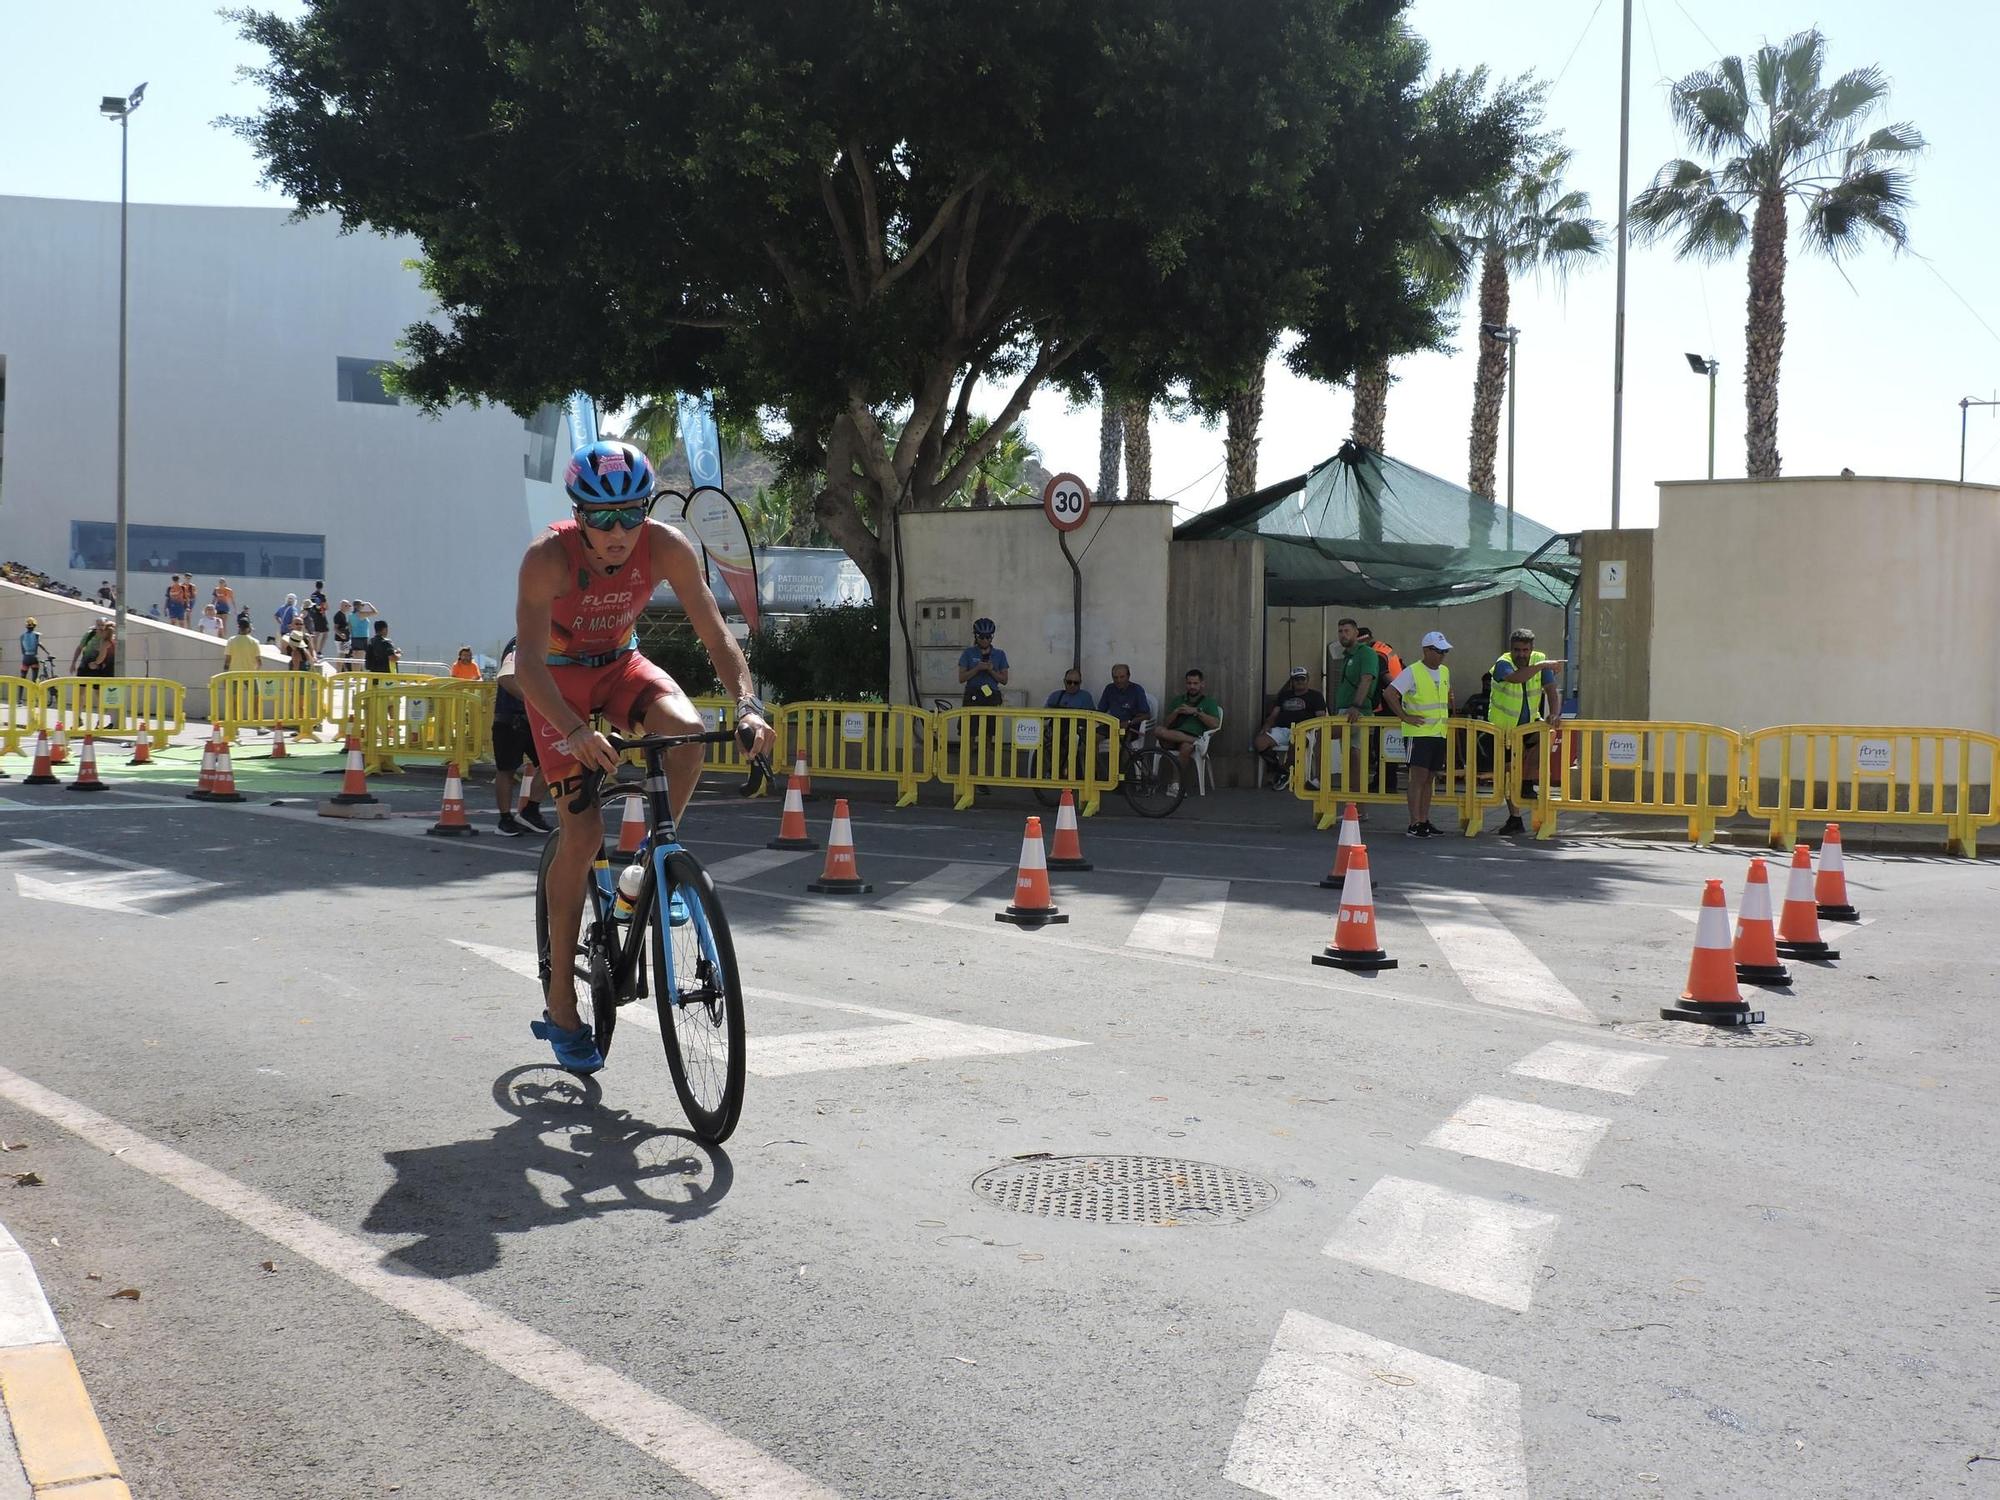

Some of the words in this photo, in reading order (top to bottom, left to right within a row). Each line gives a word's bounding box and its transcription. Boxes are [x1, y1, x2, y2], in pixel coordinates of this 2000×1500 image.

[1055, 491, 1082, 513] 30
[778, 574, 824, 583] PATRONATO
[778, 584, 824, 593] DEPORTIVO
[588, 610, 634, 632] MACHIN
